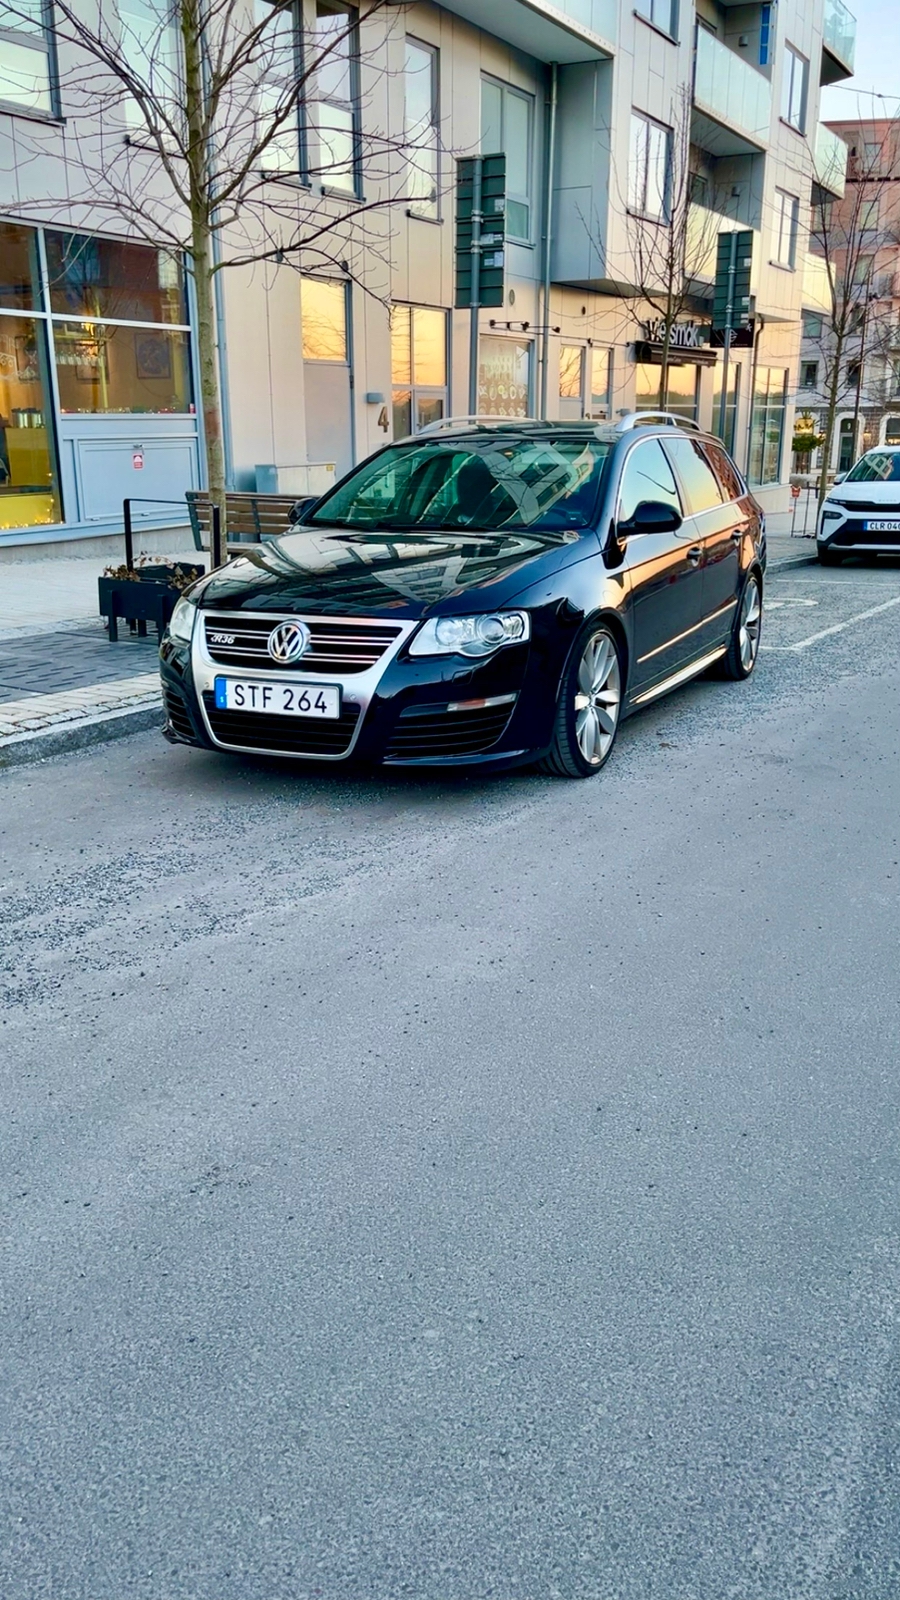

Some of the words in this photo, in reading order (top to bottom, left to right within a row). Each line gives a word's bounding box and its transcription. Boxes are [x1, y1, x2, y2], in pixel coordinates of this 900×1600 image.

[377, 406, 390, 433] 4
[869, 522, 886, 530] CLR
[211, 634, 236, 645] R36
[269, 621, 305, 662] VW
[234, 684, 273, 709] STF
[283, 688, 328, 714] 264
